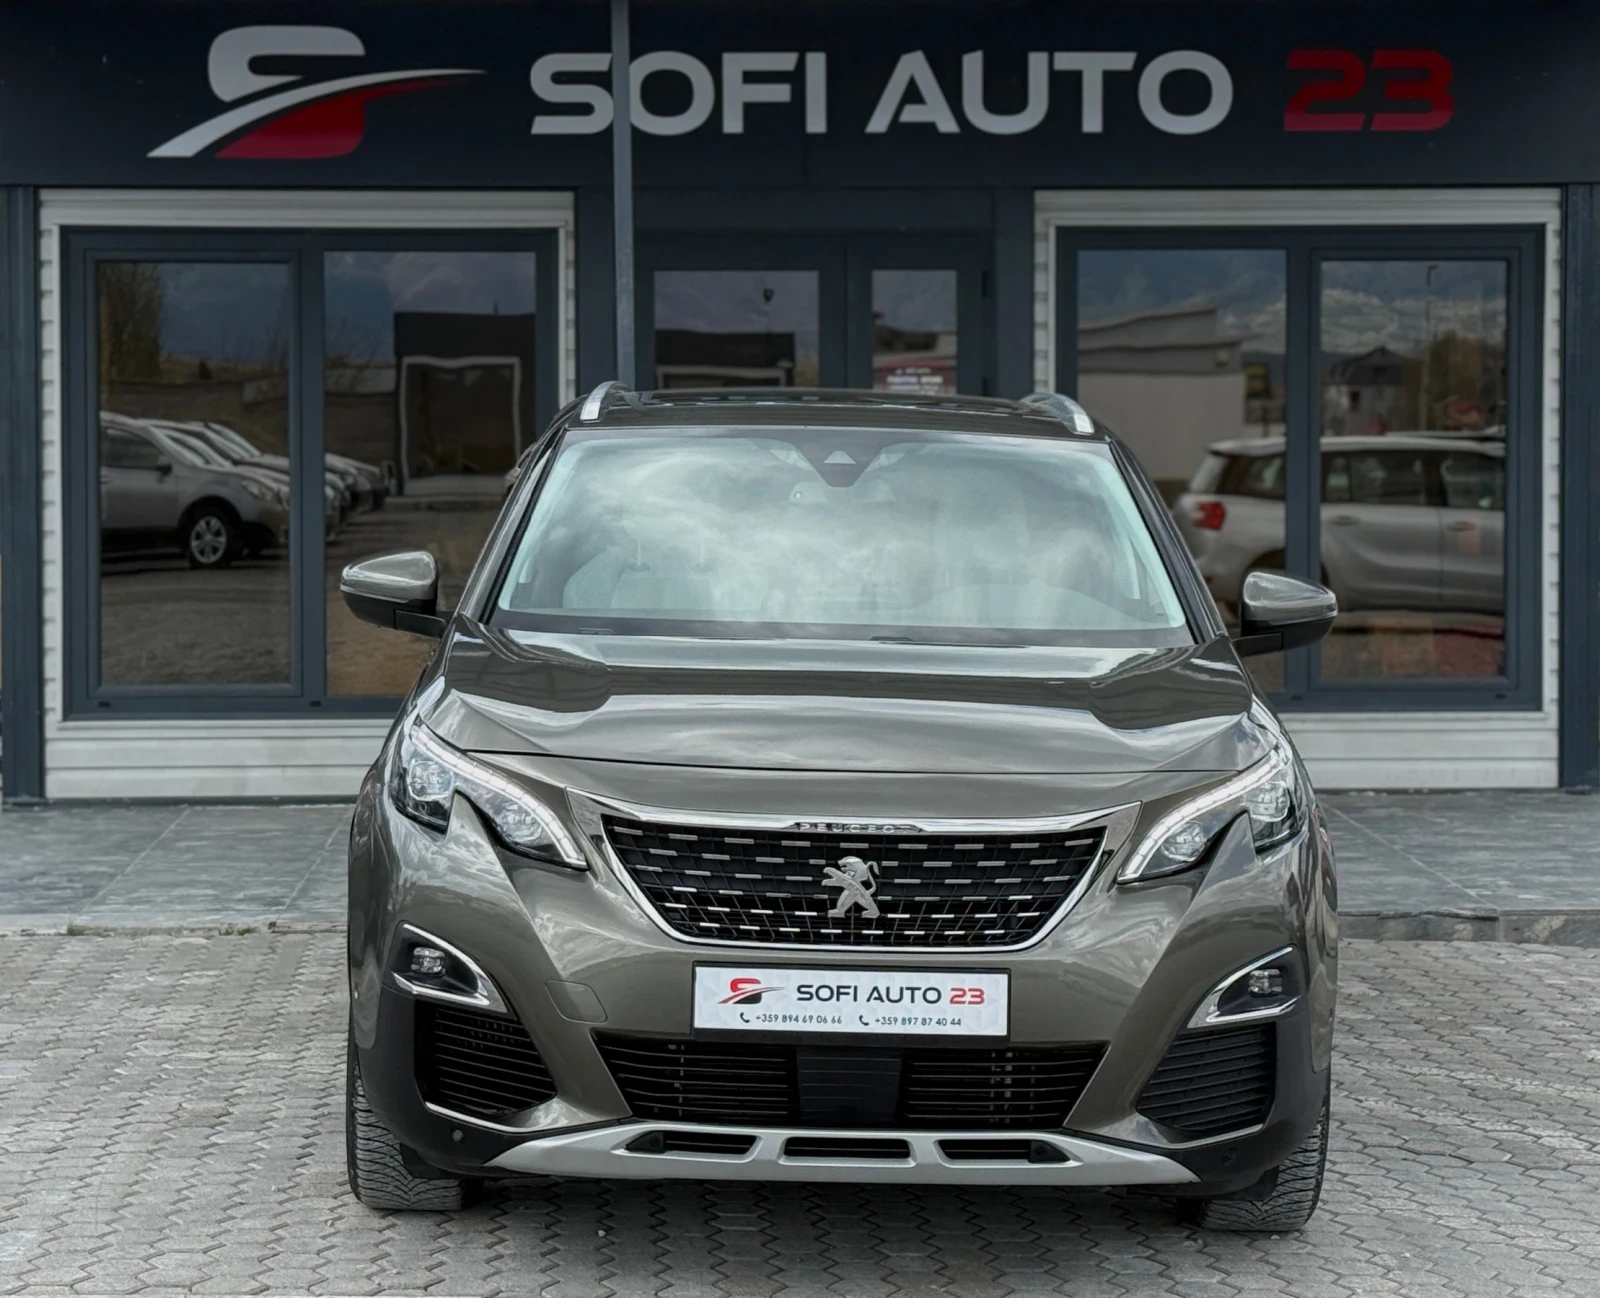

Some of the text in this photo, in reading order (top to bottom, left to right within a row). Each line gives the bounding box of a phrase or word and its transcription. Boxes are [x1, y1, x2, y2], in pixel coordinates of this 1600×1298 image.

[530, 50, 1454, 135] SOFI AUTO 23
[796, 984, 985, 1005] SOFI AUTO 23
[755, 1013, 843, 1025] +359 894 69 06 66
[874, 1016, 962, 1027] +359 897 87 40 44
